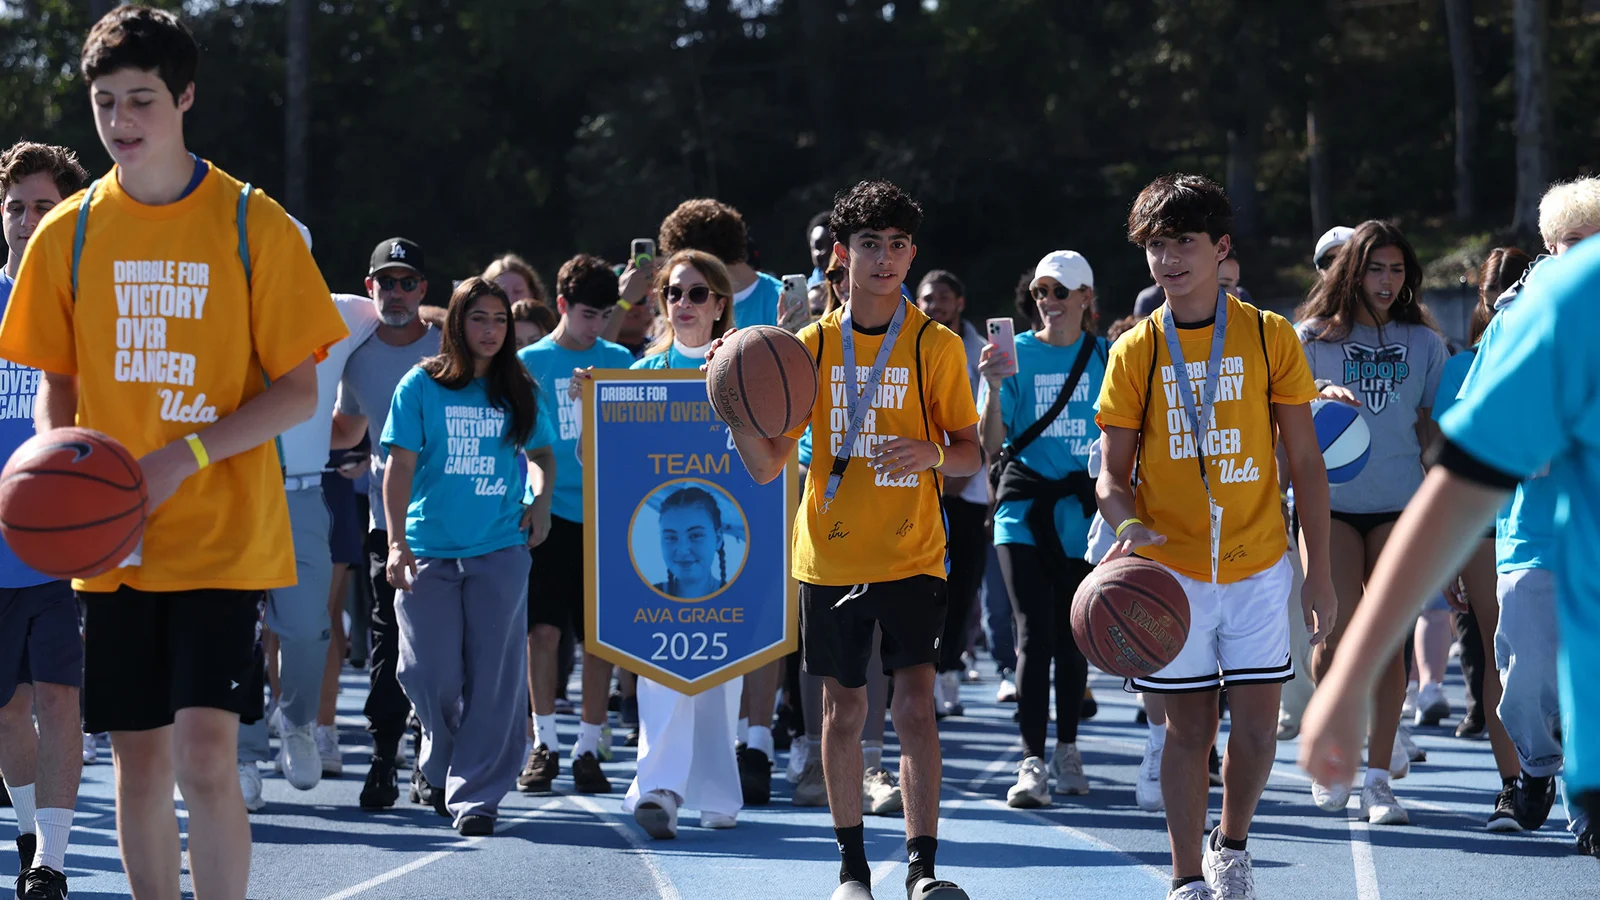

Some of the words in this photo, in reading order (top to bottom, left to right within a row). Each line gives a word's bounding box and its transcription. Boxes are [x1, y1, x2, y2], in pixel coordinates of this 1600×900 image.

[113, 260, 175, 283] DRIBBLE
[177, 261, 210, 286] FOR
[114, 284, 208, 320] VICTORY
[116, 317, 167, 349] OVER
[114, 350, 197, 386] CANCER
[1219, 356, 1244, 375] FOR
[1343, 360, 1410, 385] HOOP
[884, 367, 909, 384] FOR
[1034, 373, 1069, 386] DRIBBL
[601, 387, 645, 401] DRIBBLE
[646, 386, 667, 401] FOR
[1360, 379, 1393, 392] LIFE
[160, 388, 219, 423] Ucla
[445, 406, 484, 419] DRIBBLE
[601, 402, 667, 423] VICTORY
[670, 402, 711, 422] OVER
[446, 418, 504, 437] VICTORY
[709, 424, 721, 432] AT
[830, 408, 876, 432] OVR
[447, 437, 480, 456] OVER
[1070, 438, 1092, 456] Ucl
[1169, 428, 1241, 460] CANCER
[444, 456, 495, 475] CANCER
[648, 453, 731, 475] TEAM
[1219, 457, 1260, 483] Ucla
[475, 477, 507, 496] Ucla
[633, 607, 674, 624] AVA
[677, 607, 744, 624] GRACE
[650, 631, 729, 660] 2025
